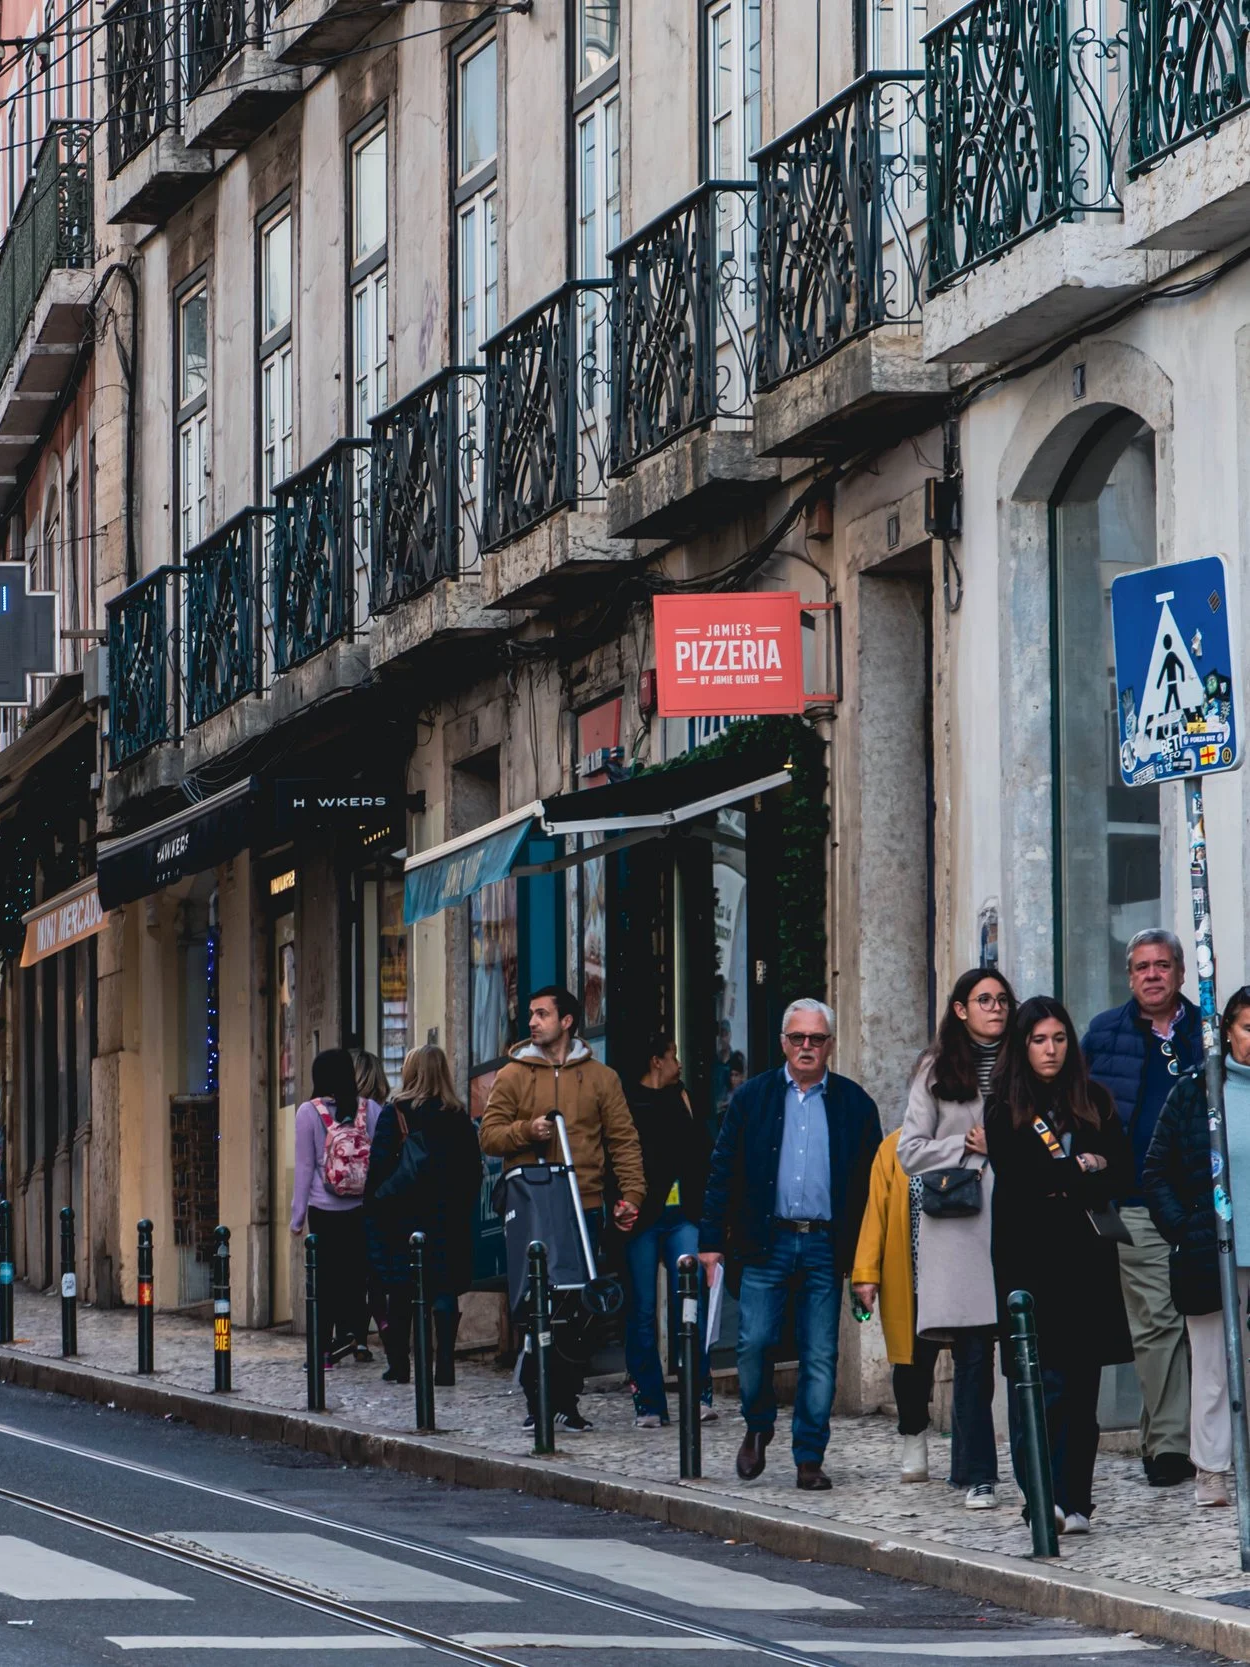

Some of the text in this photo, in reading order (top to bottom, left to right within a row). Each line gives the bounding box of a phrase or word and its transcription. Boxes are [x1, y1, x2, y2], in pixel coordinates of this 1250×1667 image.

[706, 624, 751, 637] JAMIE'S
[675, 639, 782, 671] PIZZERIA
[700, 674, 760, 685] BY JAMIE OLIVER
[37, 912, 57, 953] MINI
